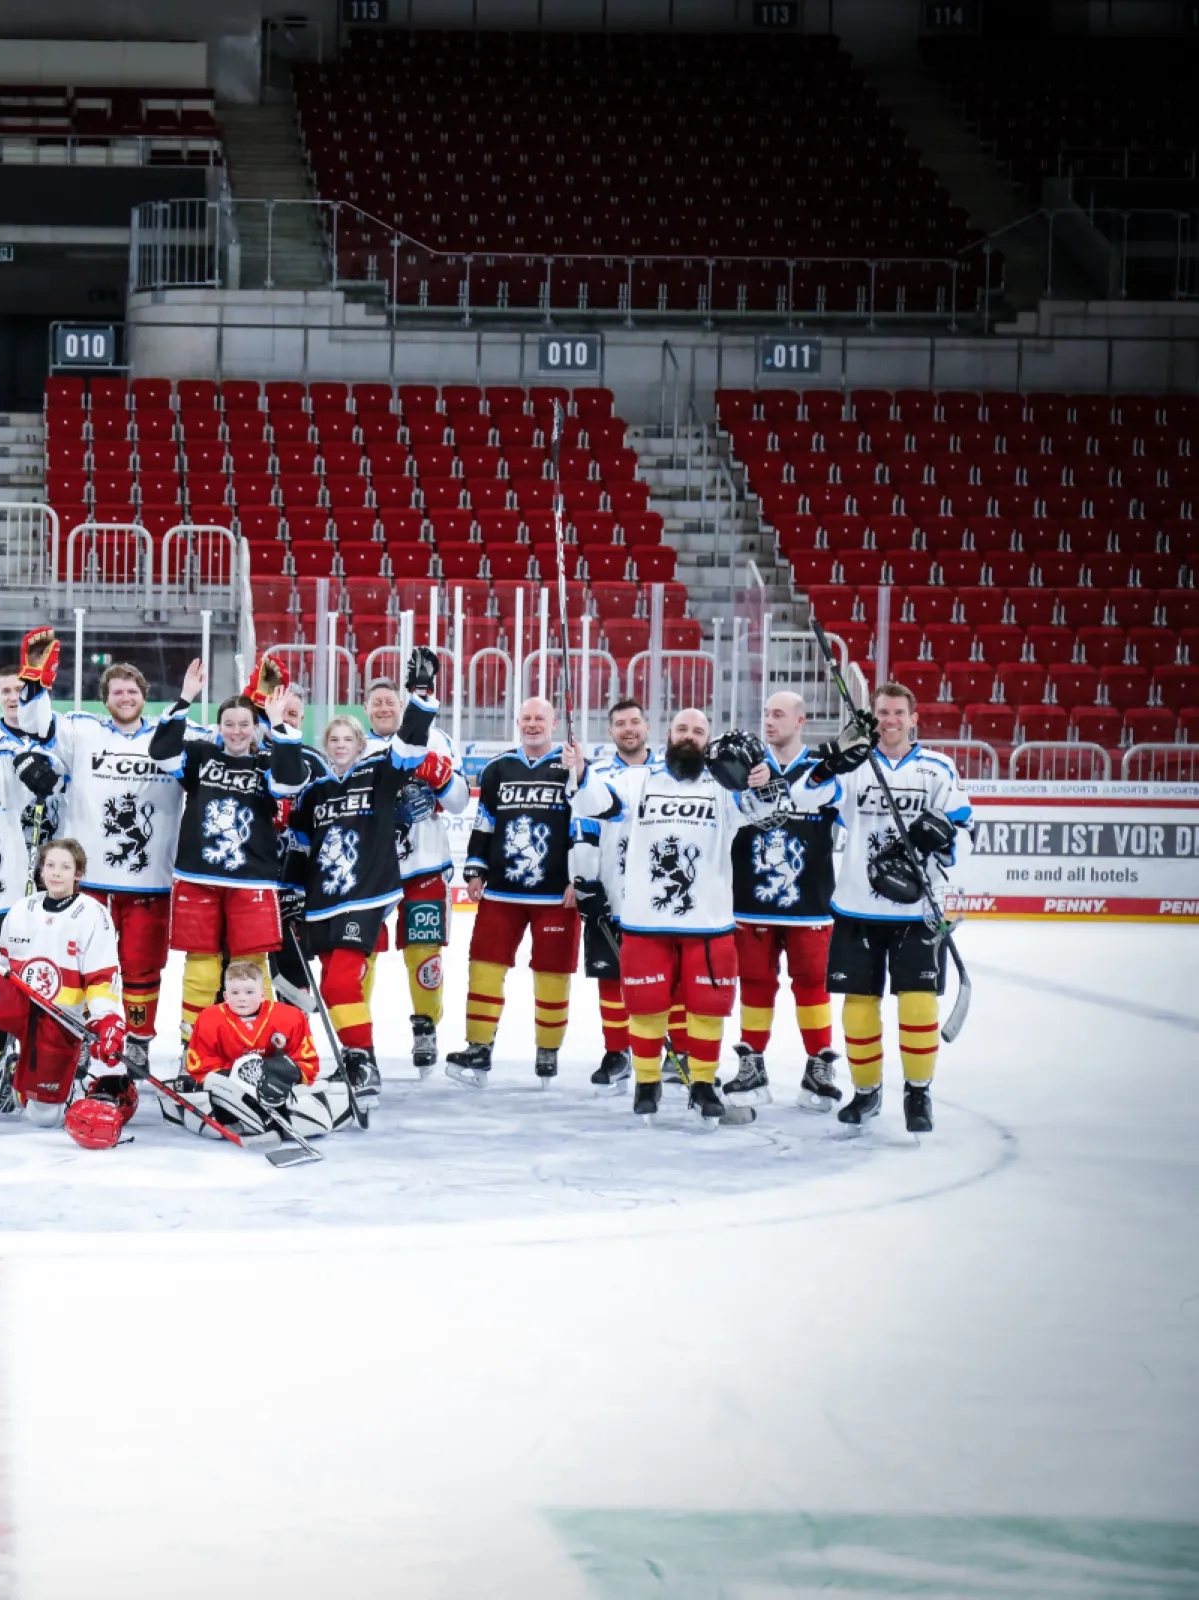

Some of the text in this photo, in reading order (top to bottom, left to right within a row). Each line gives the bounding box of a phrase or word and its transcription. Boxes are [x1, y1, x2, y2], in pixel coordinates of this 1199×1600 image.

[350, 2, 380, 18] 113
[761, 7, 790, 24] 113
[934, 7, 963, 25] 114
[65, 334, 105, 358] 010
[547, 341, 588, 366] 010
[773, 344, 810, 369] 011
[497, 785, 564, 804] ÖLKEL
[974, 822, 1199, 856] ARTIE IST VOR D
[1006, 866, 1139, 883] me and all hotels
[1159, 900, 1199, 914] PEN
[408, 928, 442, 941] Bank
